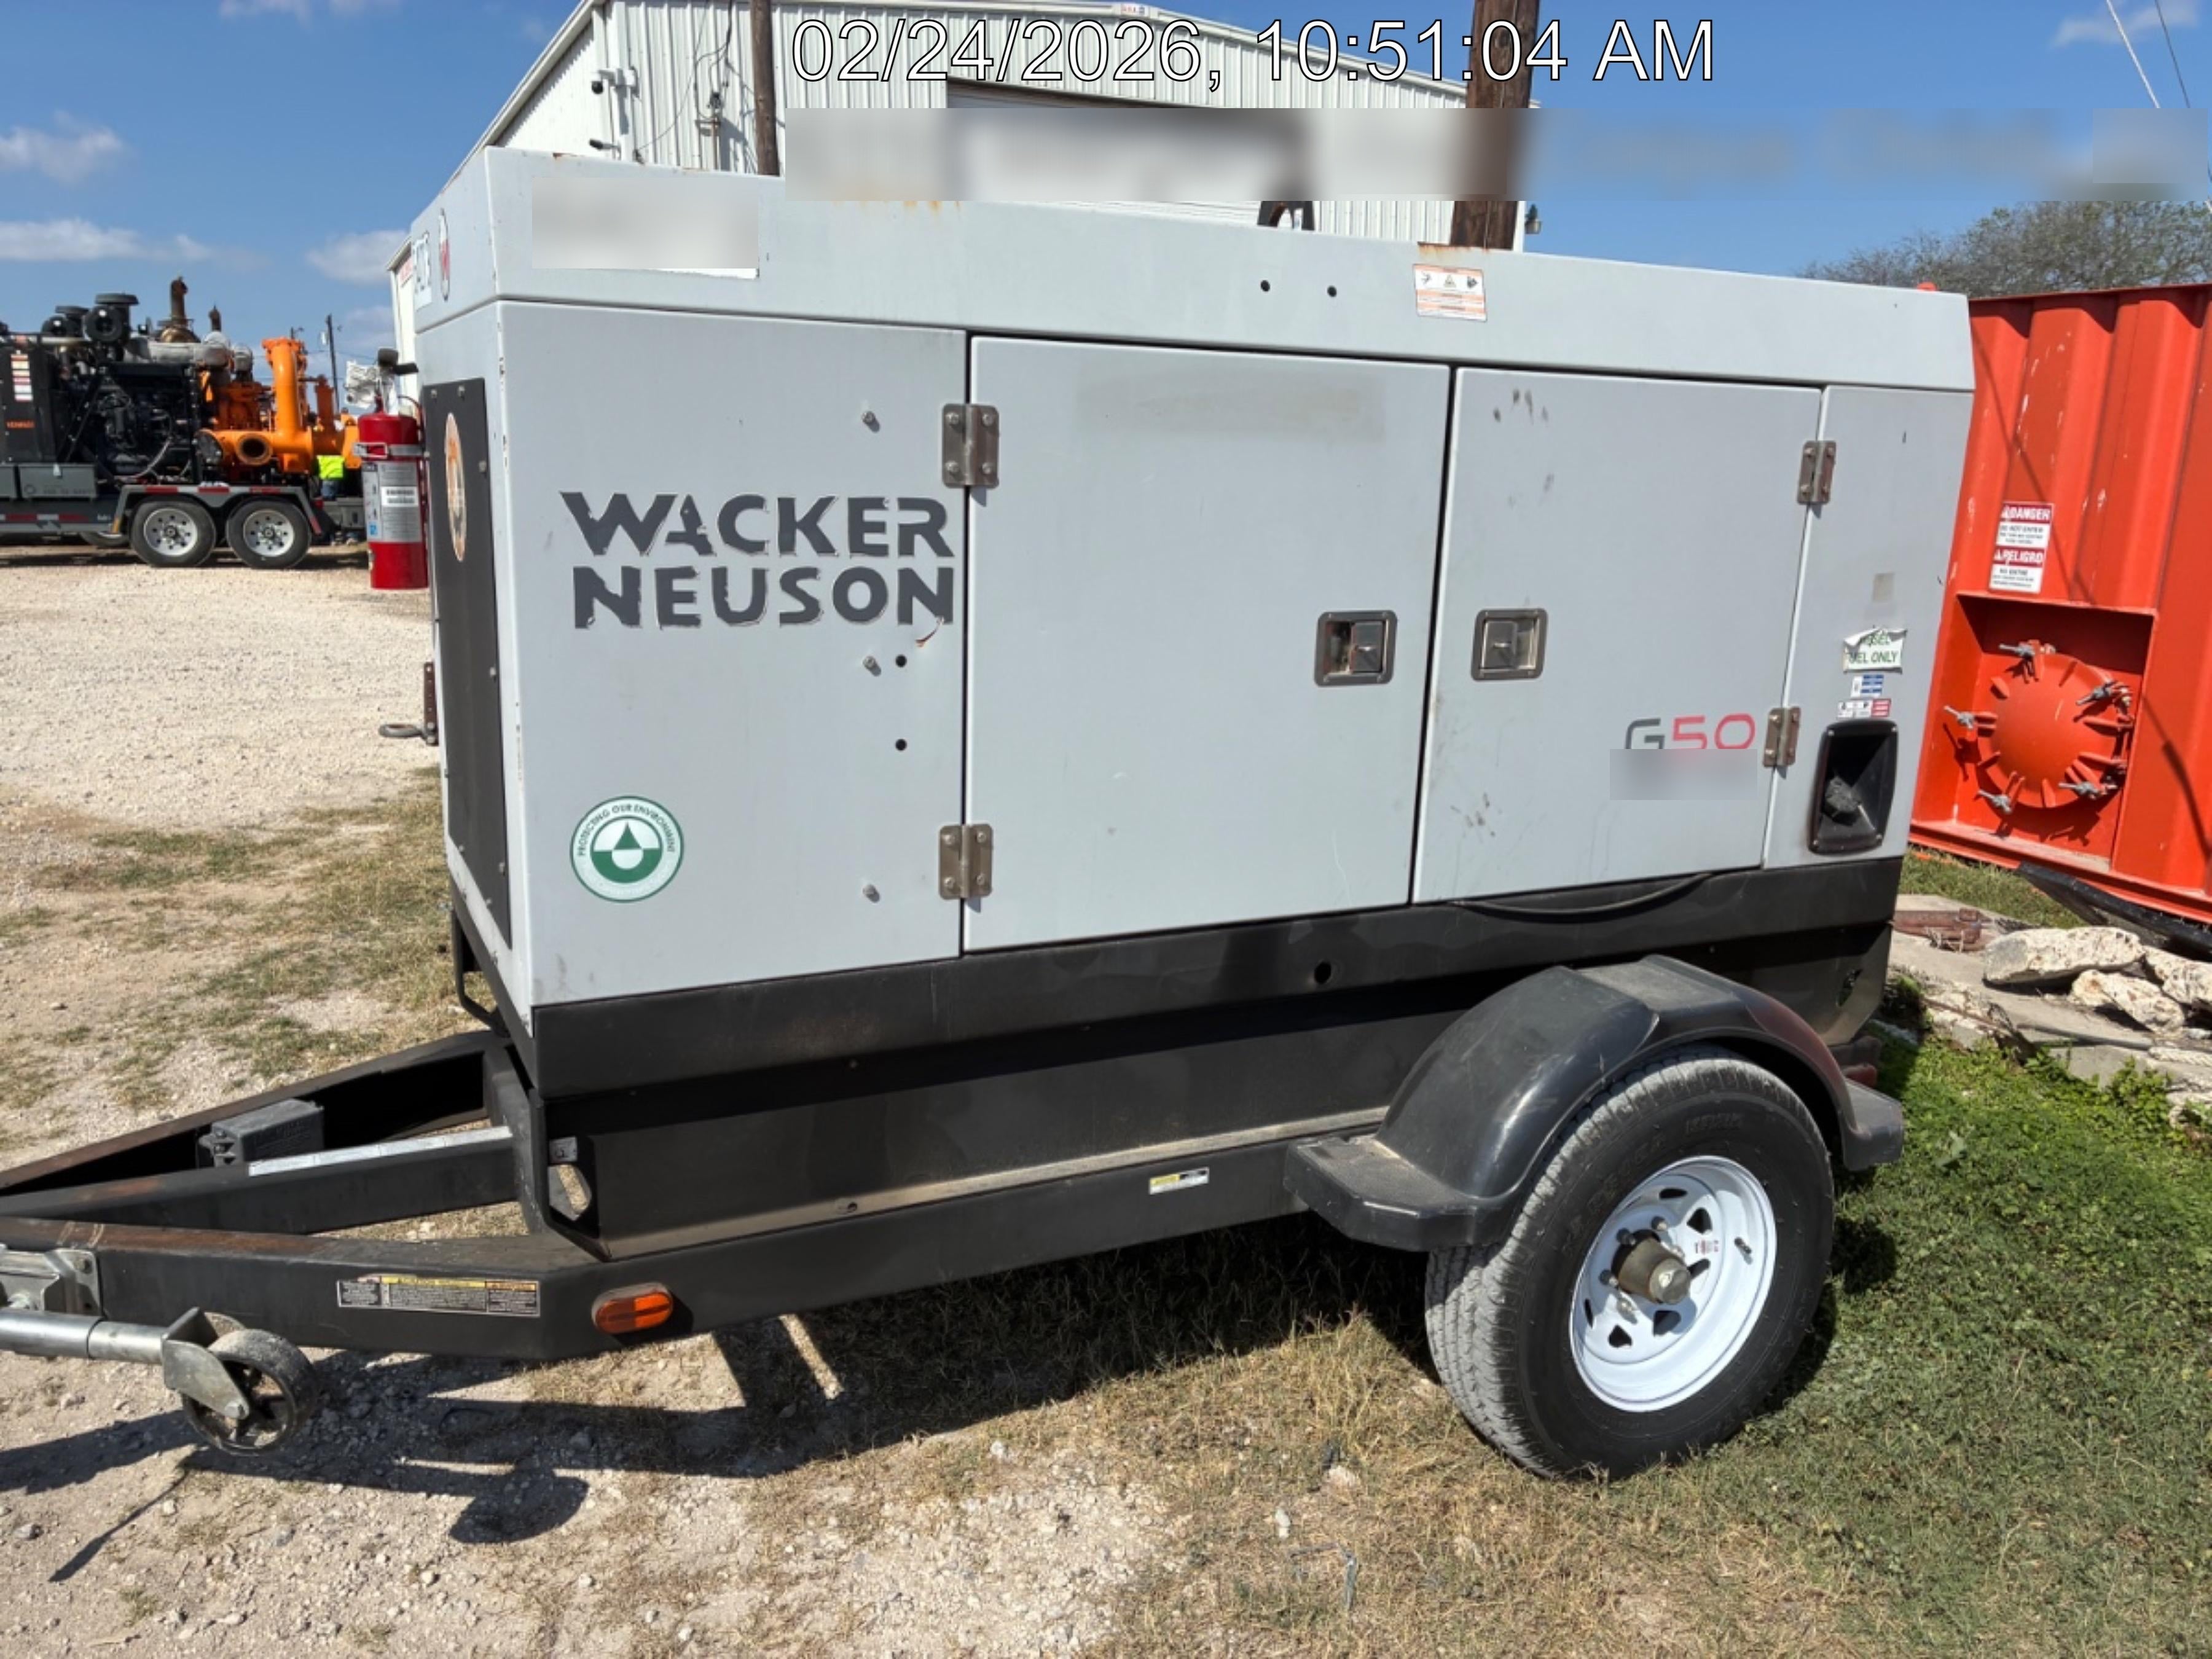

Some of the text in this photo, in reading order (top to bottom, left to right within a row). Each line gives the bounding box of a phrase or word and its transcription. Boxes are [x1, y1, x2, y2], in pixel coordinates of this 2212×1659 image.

[2007, 506, 2051, 520] DANGER
[559, 491, 955, 557] WACKER
[2003, 549, 2044, 563] PELIGRO
[573, 565, 954, 629] NEUSON
[1871, 650, 1897, 663] ONLY
[1625, 712, 1755, 750] G50
[612, 804, 632, 814] OUR
